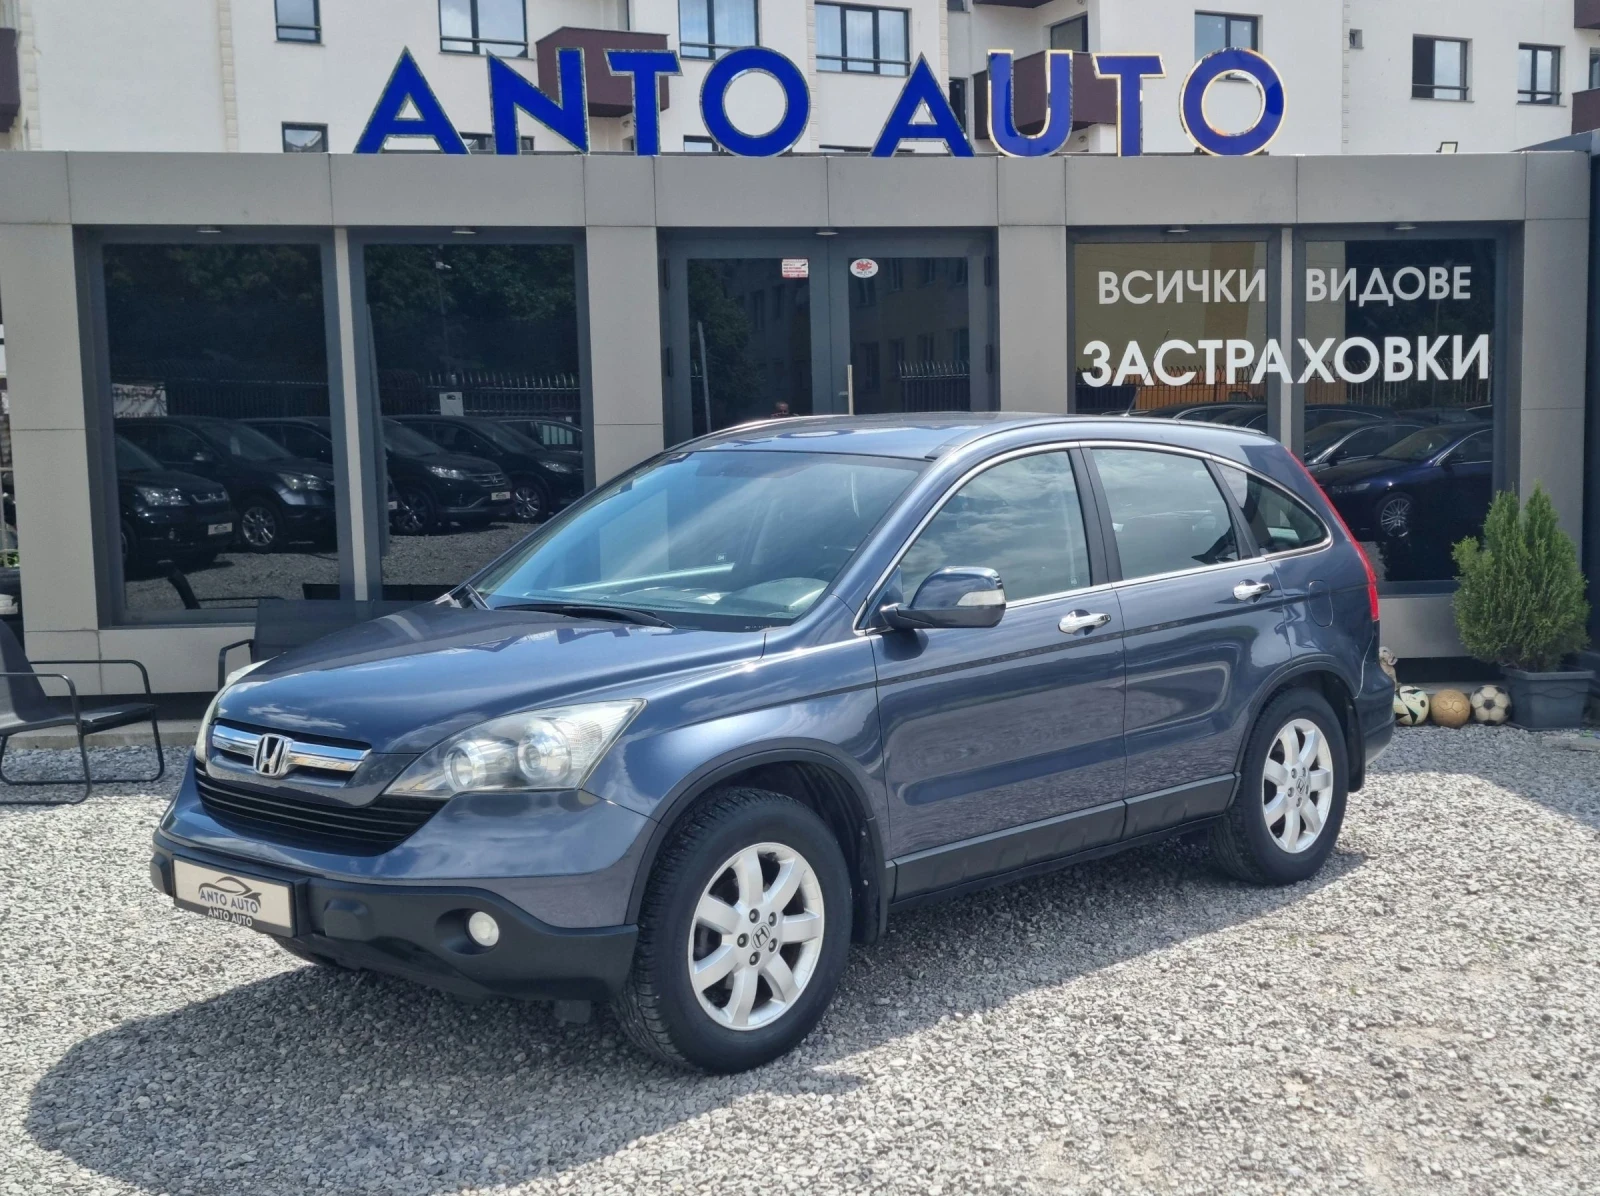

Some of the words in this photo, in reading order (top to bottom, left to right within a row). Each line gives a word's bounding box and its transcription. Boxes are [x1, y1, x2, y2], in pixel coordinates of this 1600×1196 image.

[352, 45, 811, 157] ANTO
[868, 46, 1287, 157] AUTO
[1098, 268, 1267, 304] ВСИЧКИ
[1305, 265, 1472, 307] ВИДОВЕ
[1081, 333, 1490, 388] ЗАСТРАХОВКИ
[199, 889, 227, 906] ANTO
[230, 897, 258, 914] AUTO
[208, 906, 230, 921] ANTO
[231, 912, 253, 927] AUTO
